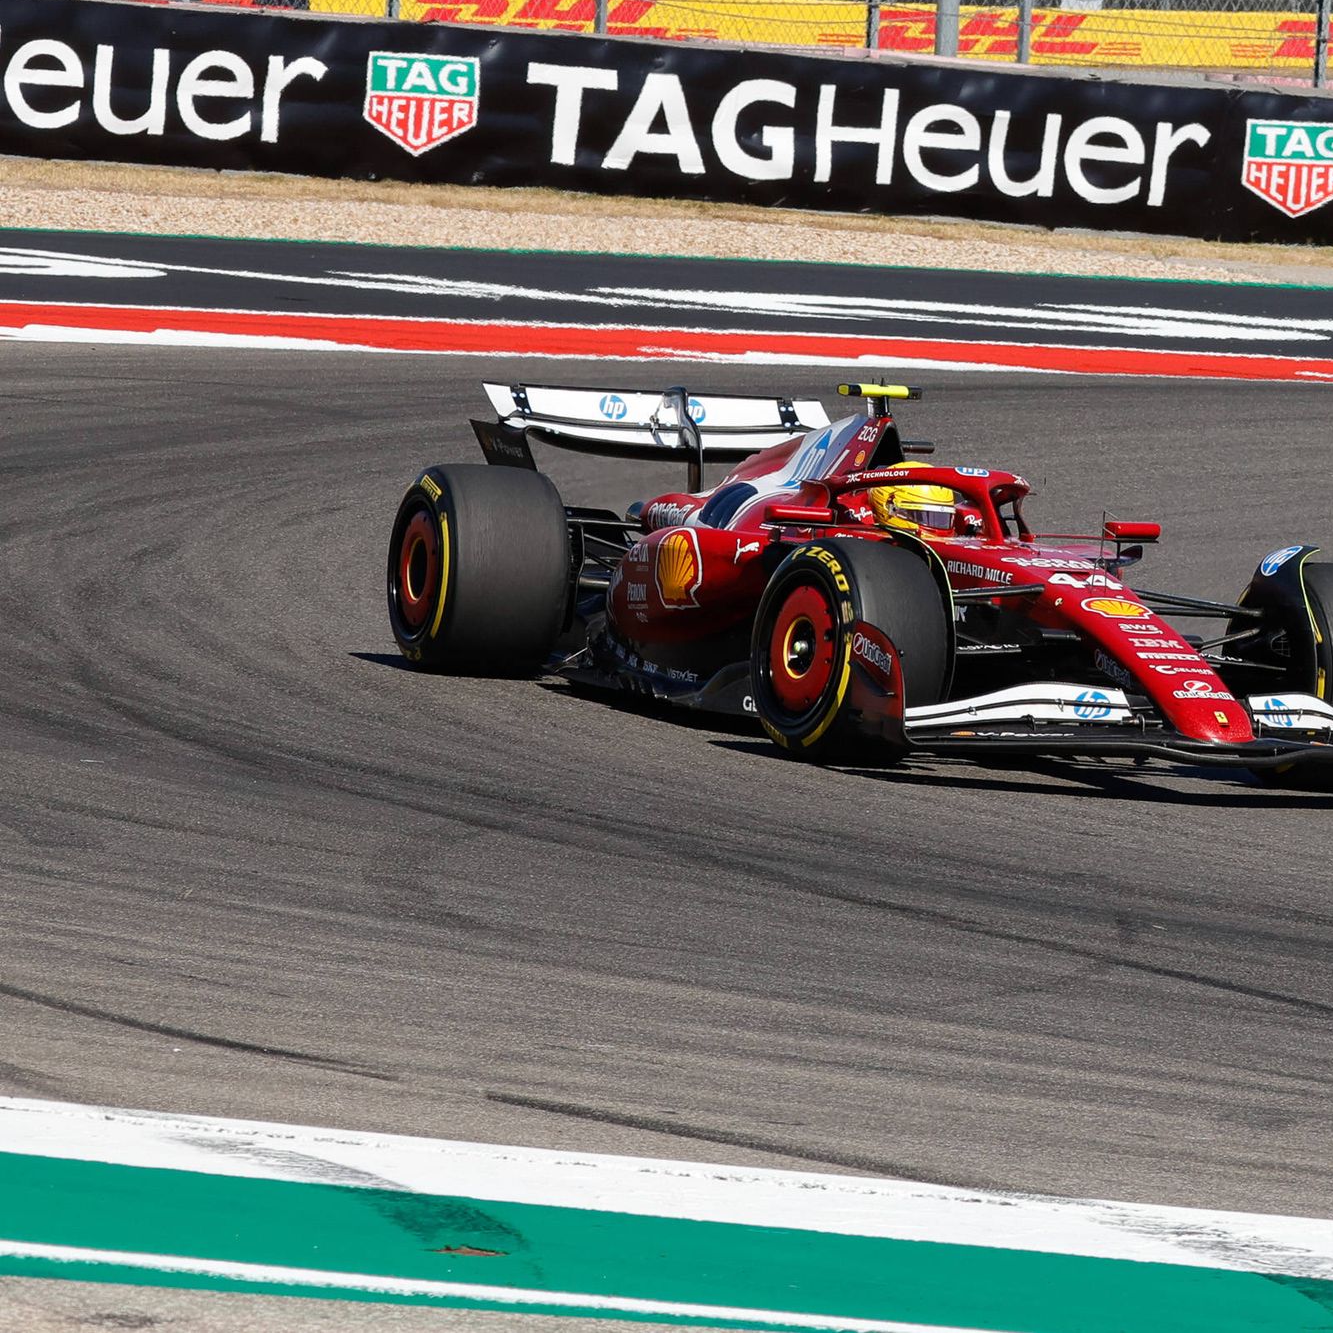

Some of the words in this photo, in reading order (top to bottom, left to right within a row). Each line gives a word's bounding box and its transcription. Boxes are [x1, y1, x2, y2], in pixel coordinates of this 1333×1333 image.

[878, 10, 1097, 56] DHL
[377, 58, 470, 93] TAG
[3, 39, 328, 144] euer
[371, 96, 473, 147] HEUER
[601, 395, 626, 420] hp
[863, 470, 910, 479] TECHNOLOGY
[806, 546, 850, 592] ZERO
[947, 560, 984, 579] RICHARD
[984, 568, 1014, 585] MILLE
[1048, 572, 1124, 591] 44
[1128, 638, 1184, 649] IBM
[1074, 691, 1111, 719] hp
[1173, 691, 1236, 701] UniCredit
